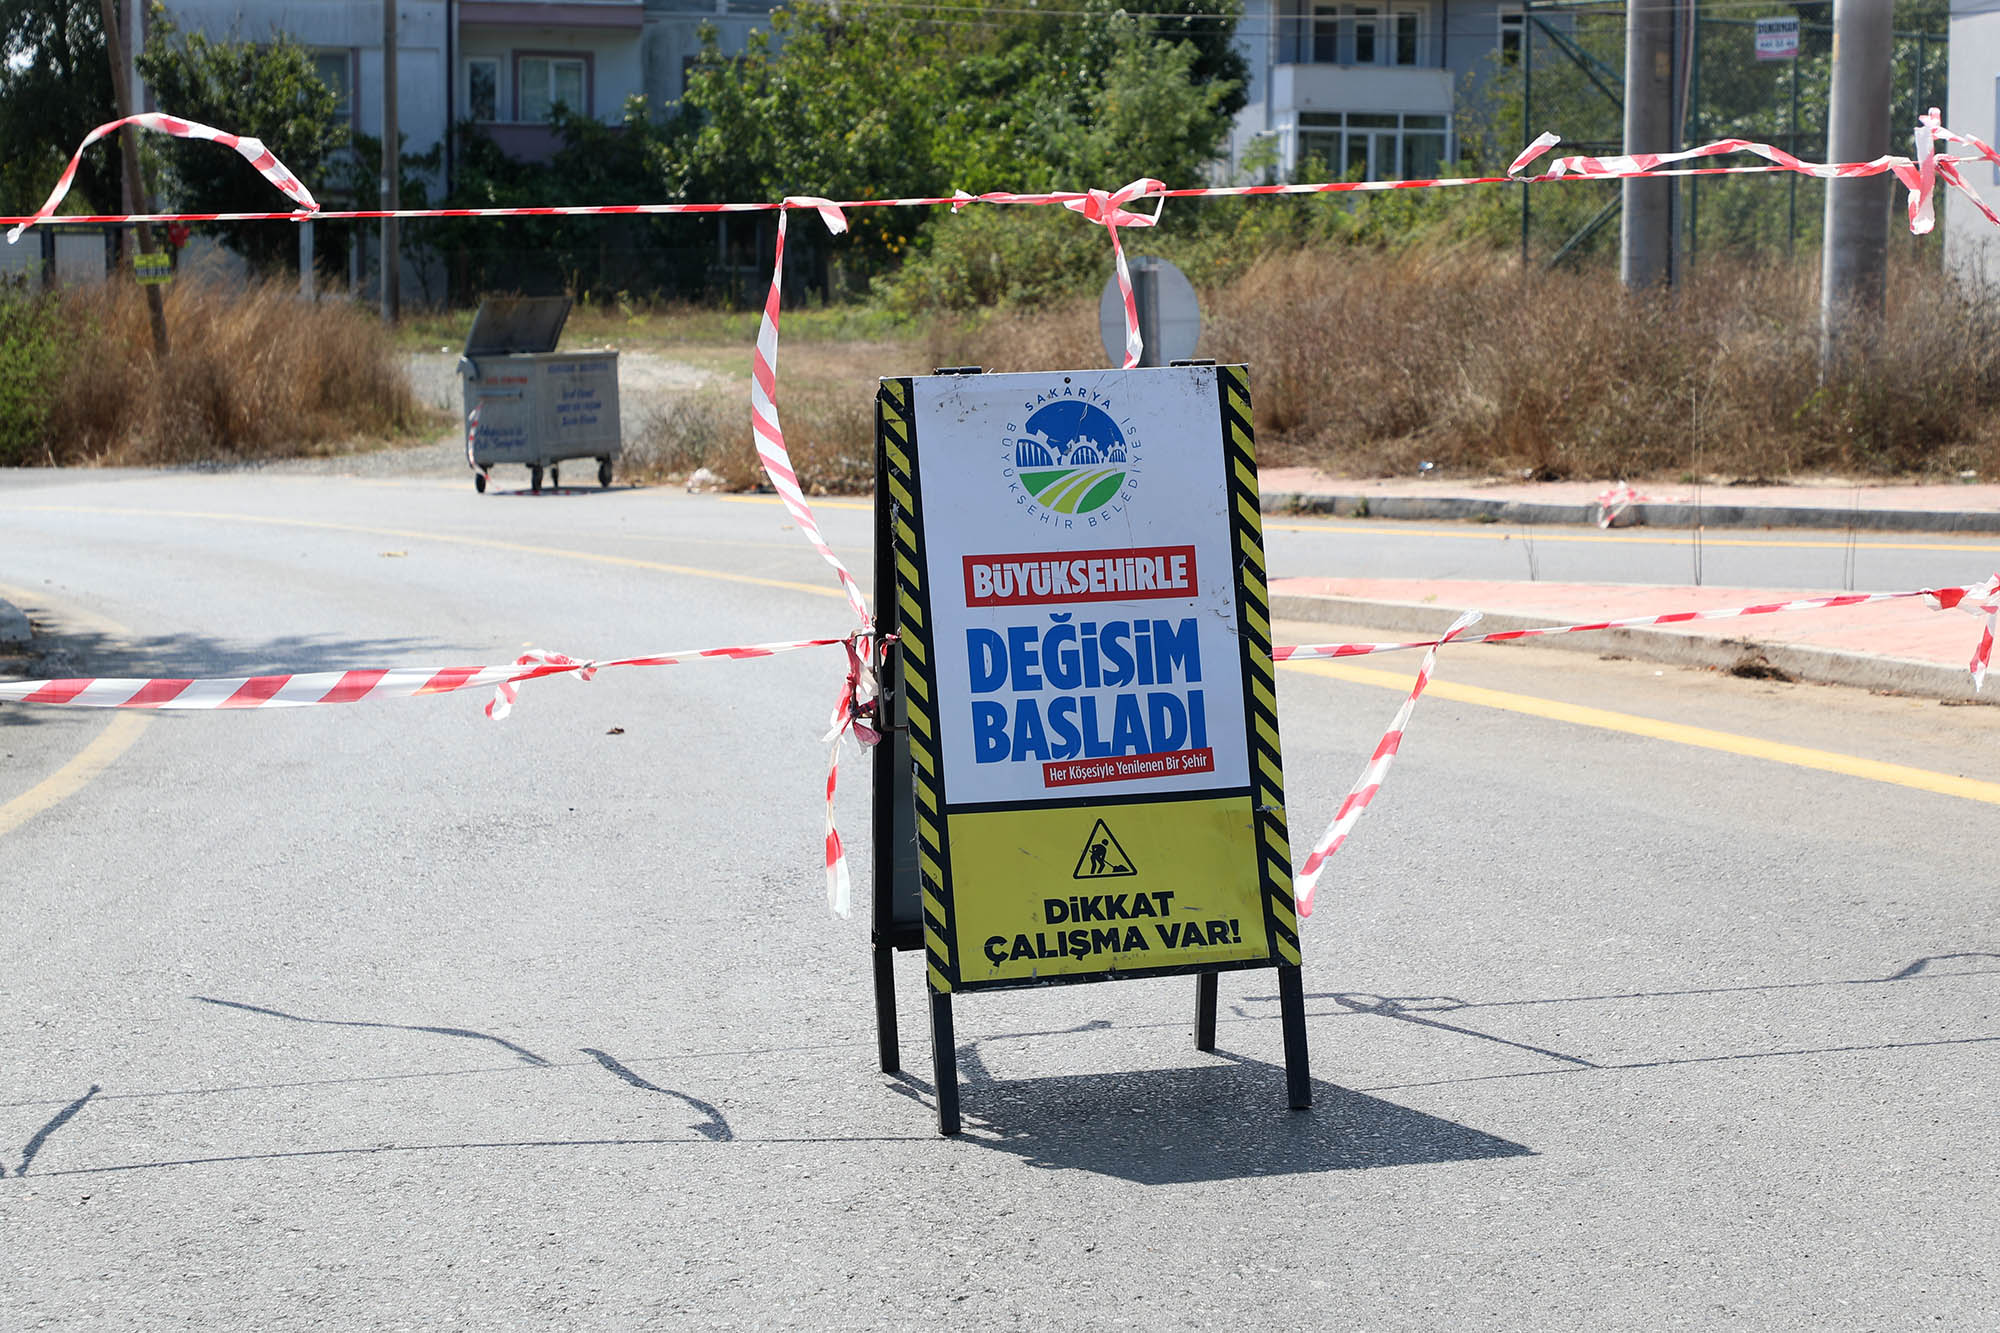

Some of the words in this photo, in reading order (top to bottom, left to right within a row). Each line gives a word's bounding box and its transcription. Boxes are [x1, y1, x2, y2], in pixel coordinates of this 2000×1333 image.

[1024, 386, 1112, 412] SAKARYA
[966, 612, 1202, 693] DEĞİŞİM
[971, 689, 1208, 764] BAŞLADI
[1049, 767, 1067, 782] Her
[1069, 762, 1115, 780] Köşesiyle
[1116, 760, 1164, 775] Yenilenen
[1166, 756, 1180, 770] Bir
[1181, 753, 1208, 770] Şehir
[1043, 891, 1175, 925] DİKKAT
[984, 925, 1150, 968] ÇALIŞMA
[1155, 919, 1242, 949] VAR!
